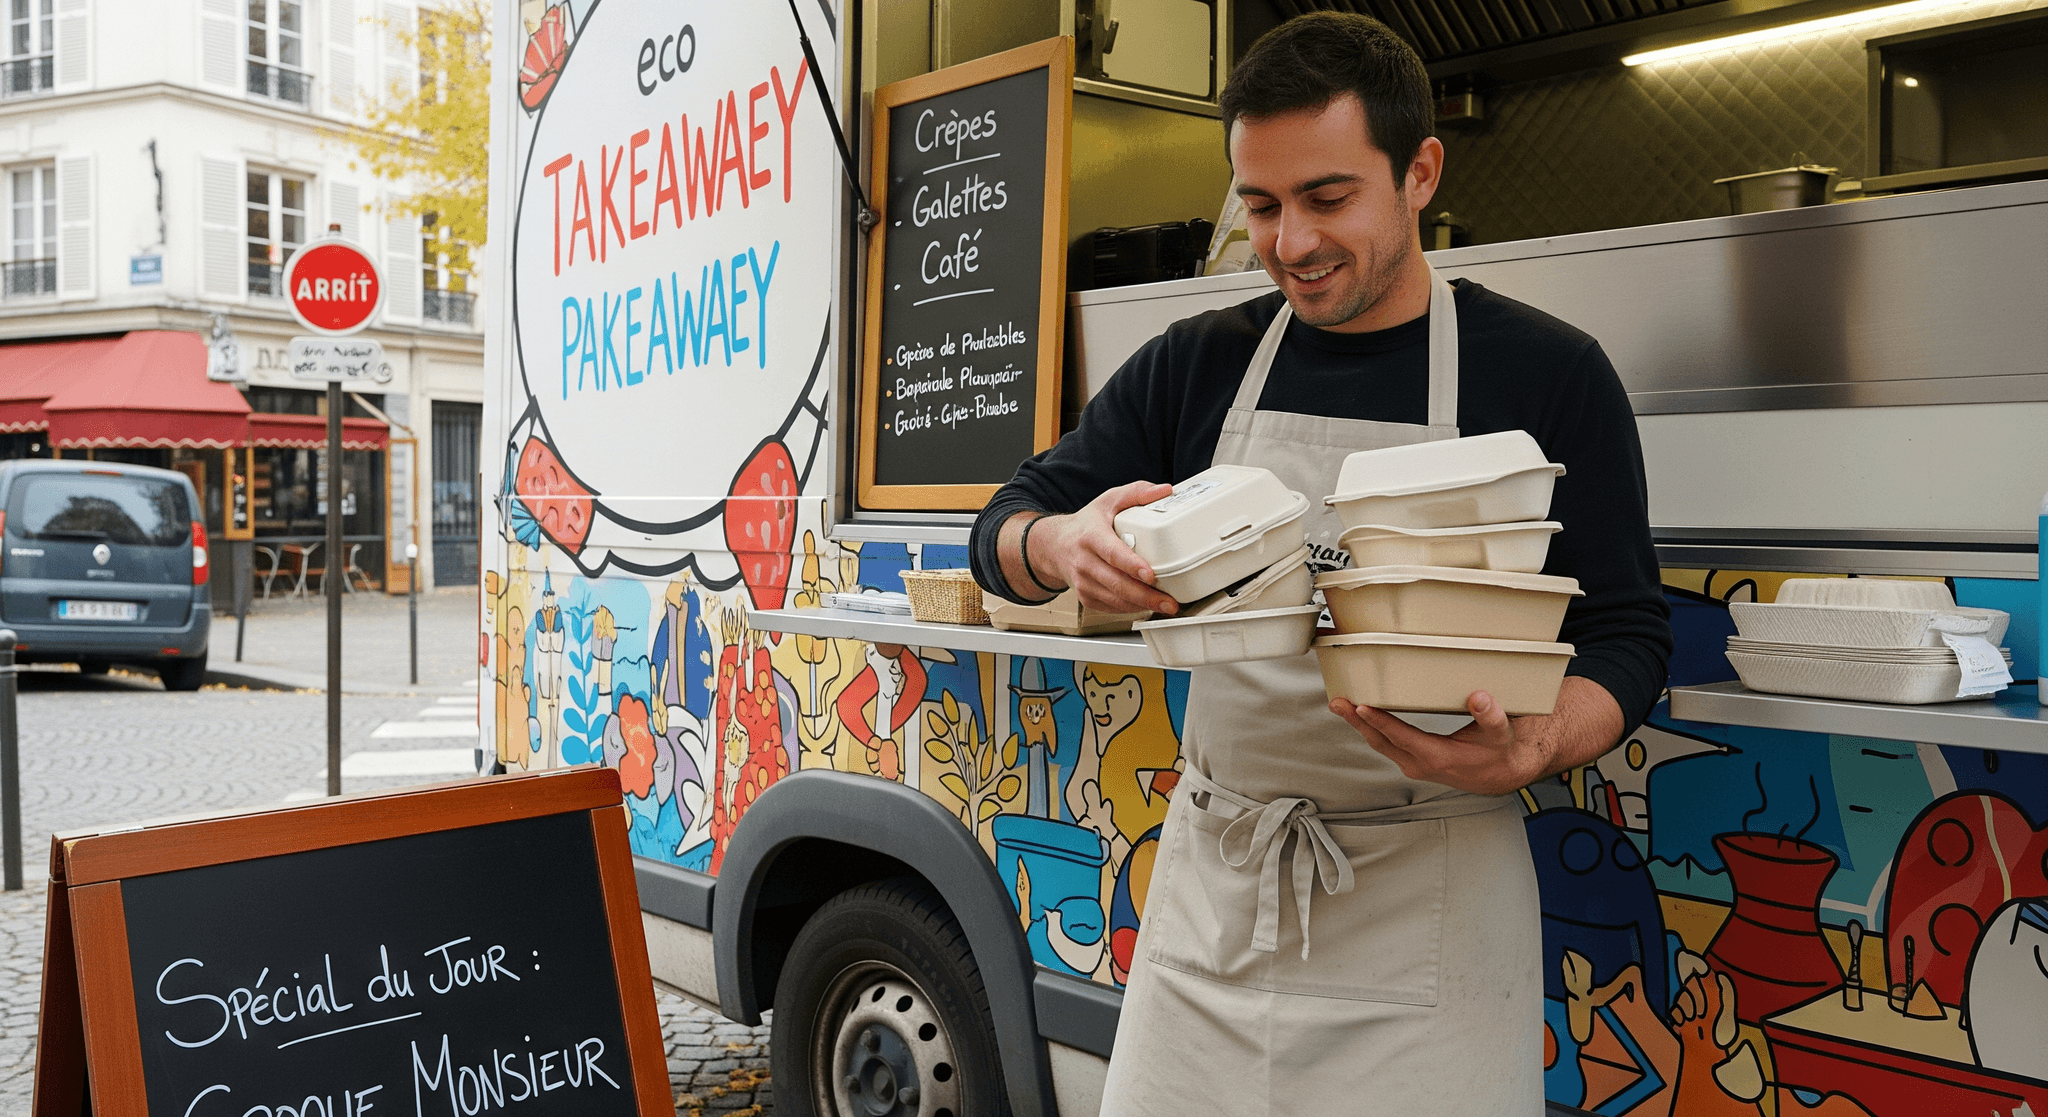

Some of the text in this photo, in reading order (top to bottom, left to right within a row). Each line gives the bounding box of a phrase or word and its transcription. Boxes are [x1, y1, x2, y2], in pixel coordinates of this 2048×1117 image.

[637, 24, 696, 96] eco
[543, 56, 809, 277] TAKEAWAEY
[912, 173, 1007, 227] Galettes
[921, 228, 982, 284] Café
[562, 240, 780, 401] PAKEAWAEY
[940, 332, 956, 356] de
[367, 944, 415, 1002] du
